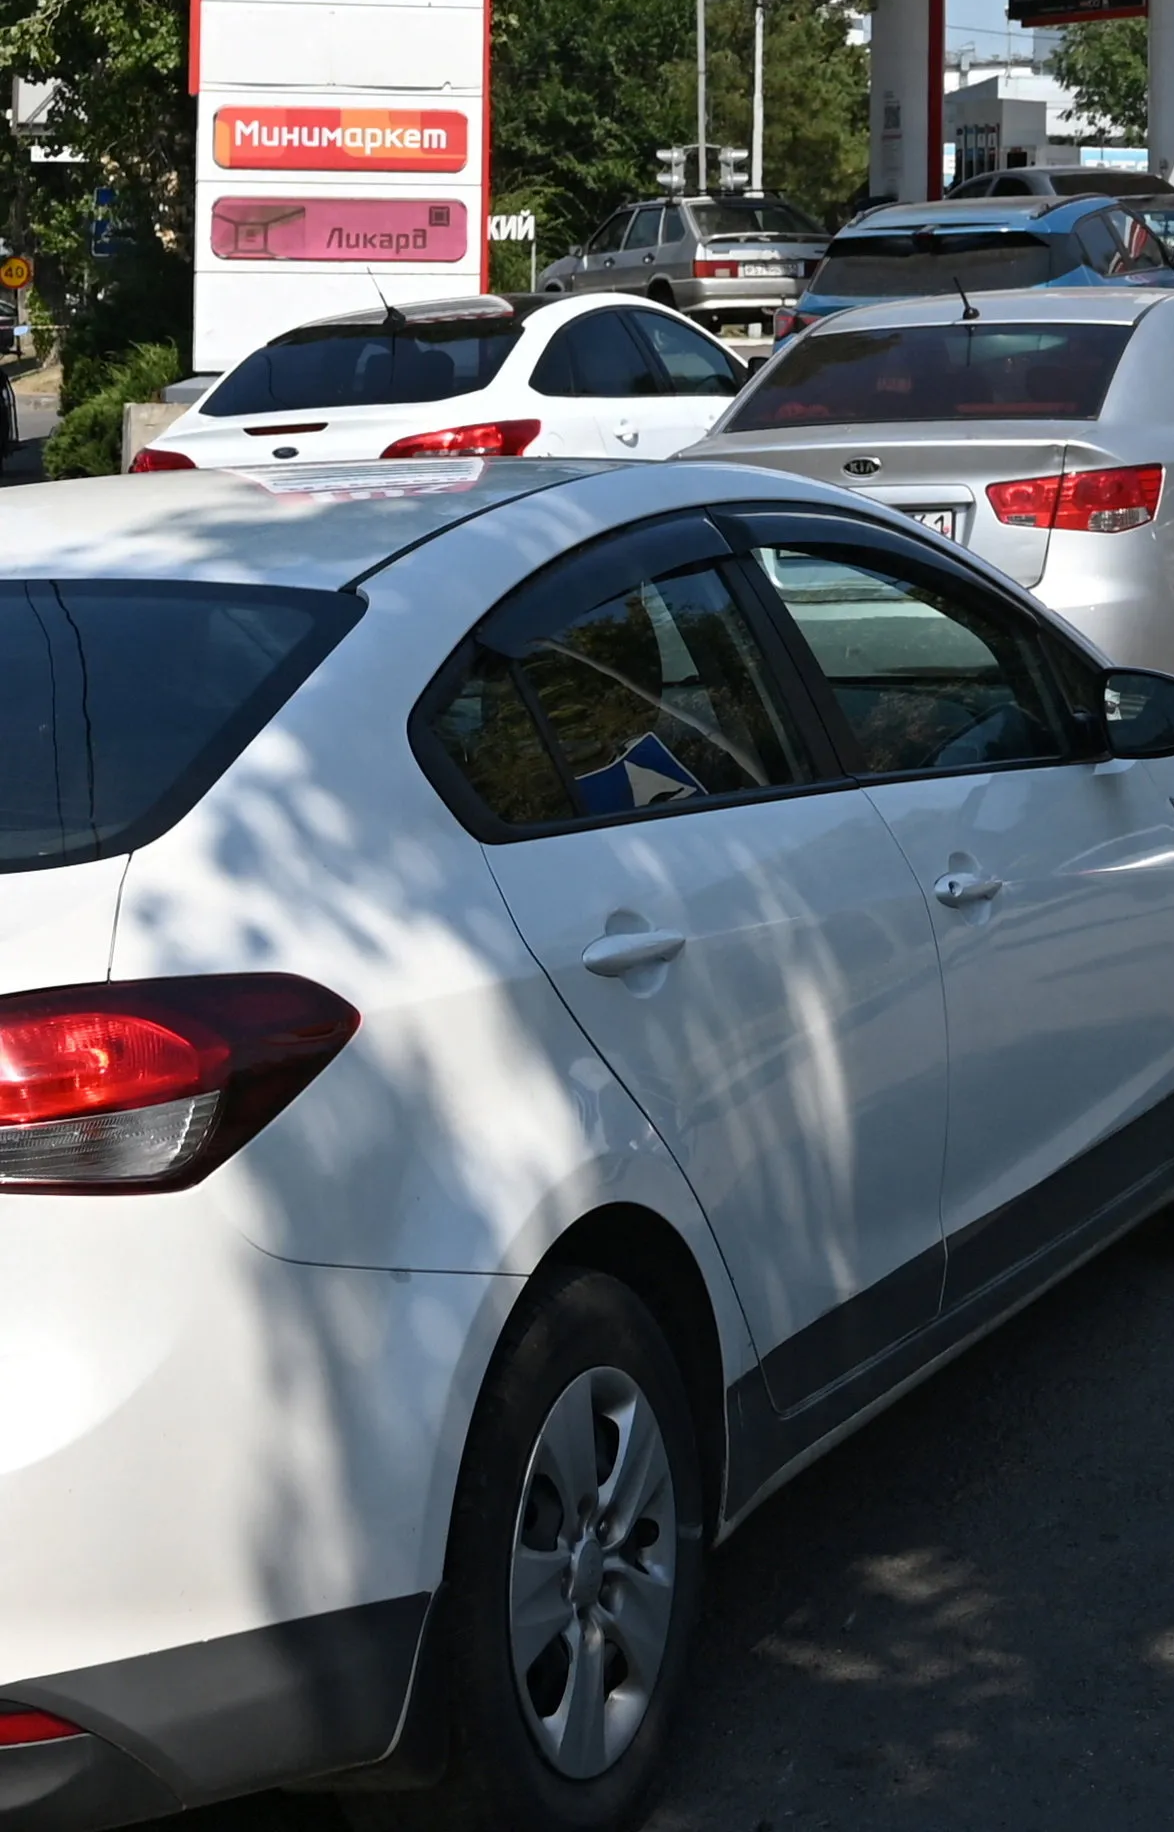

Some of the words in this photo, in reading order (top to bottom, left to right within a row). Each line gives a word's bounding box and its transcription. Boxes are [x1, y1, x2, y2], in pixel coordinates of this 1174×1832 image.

[234, 119, 448, 156] Минимаркет
[326, 227, 428, 254] Ликард
[4, 265, 25, 279] 40
